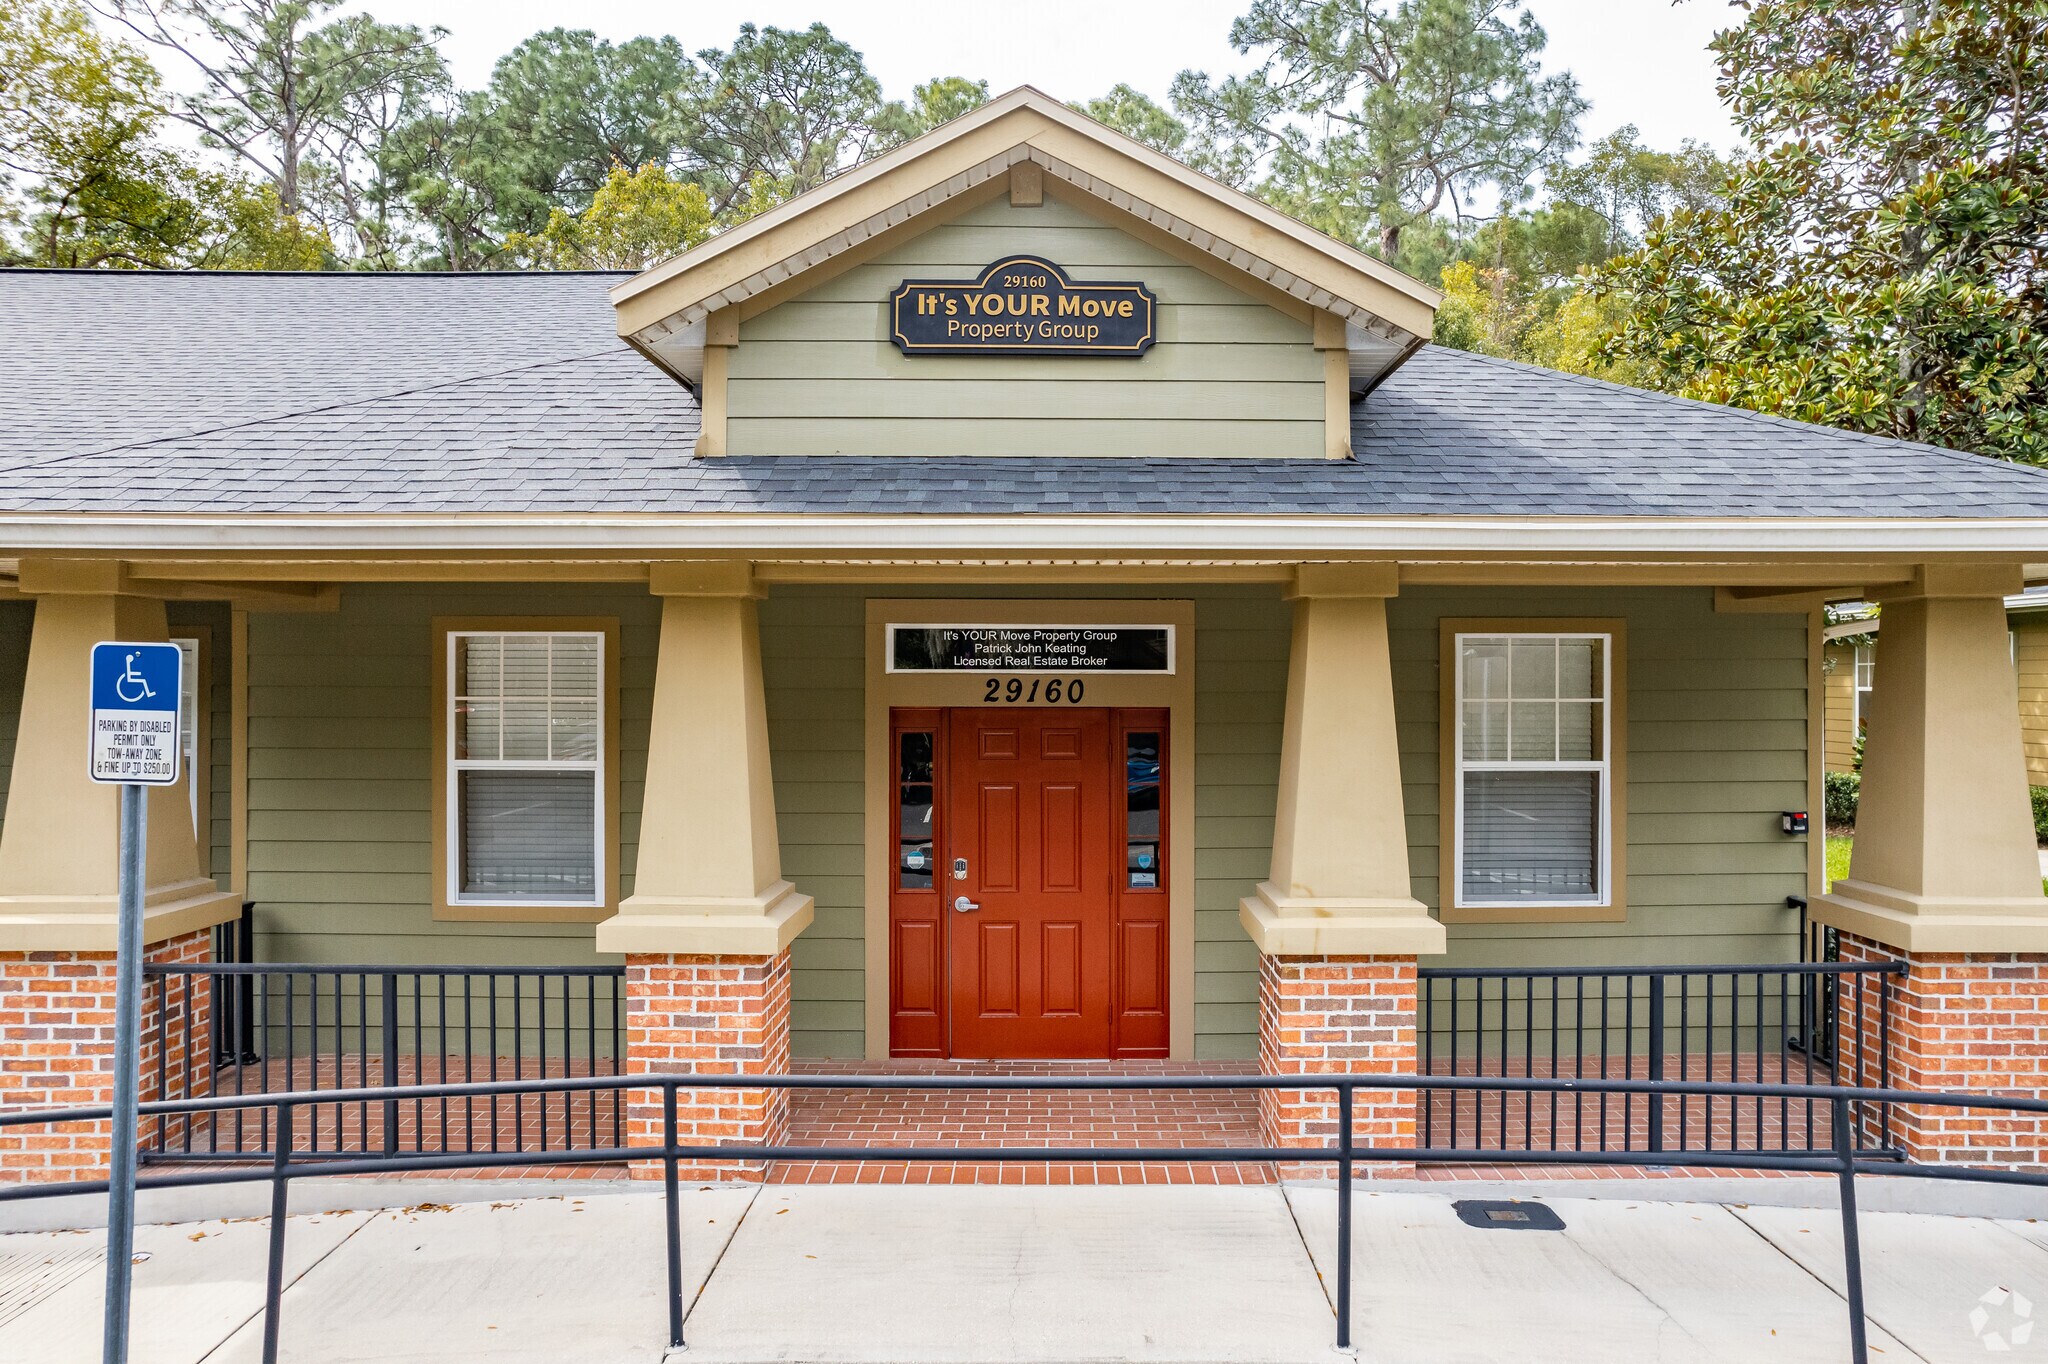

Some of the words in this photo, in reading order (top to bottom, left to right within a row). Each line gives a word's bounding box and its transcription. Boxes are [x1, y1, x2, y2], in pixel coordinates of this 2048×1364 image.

[1003, 275, 1046, 288] 29160
[917, 293, 957, 316] It's
[963, 294, 1050, 317] YOUR
[1058, 295, 1134, 318] Move
[948, 320, 1034, 342] Property
[1038, 321, 1099, 342] Group
[943, 630, 959, 641] It's
[961, 630, 998, 641] YOUR
[1000, 631, 1030, 641] Move
[1033, 631, 1080, 643] Property
[1083, 631, 1117, 643] Group
[974, 643, 1012, 653] Patrick
[1015, 643, 1042, 653] John
[1045, 643, 1086, 655] Keating
[954, 656, 1002, 666] Licensed
[1005, 656, 1030, 666] Real
[1033, 656, 1068, 666] Estate
[1071, 656, 1108, 666] Broker
[983, 678, 1085, 704] 29160
[98, 720, 127, 732] PARKING
[129, 721, 139, 732] BY
[140, 721, 172, 733] DISABLED
[113, 734, 139, 746] PERMIT
[141, 735, 157, 746] ONLY
[107, 747, 143, 760] TOW-AWAY
[145, 748, 162, 760] ZONE
[97, 761, 102, 773] &
[104, 762, 119, 773] FINE
[122, 762, 131, 773] UP
[132, 762, 142, 773] TO
[143, 763, 171, 775] $250.00
